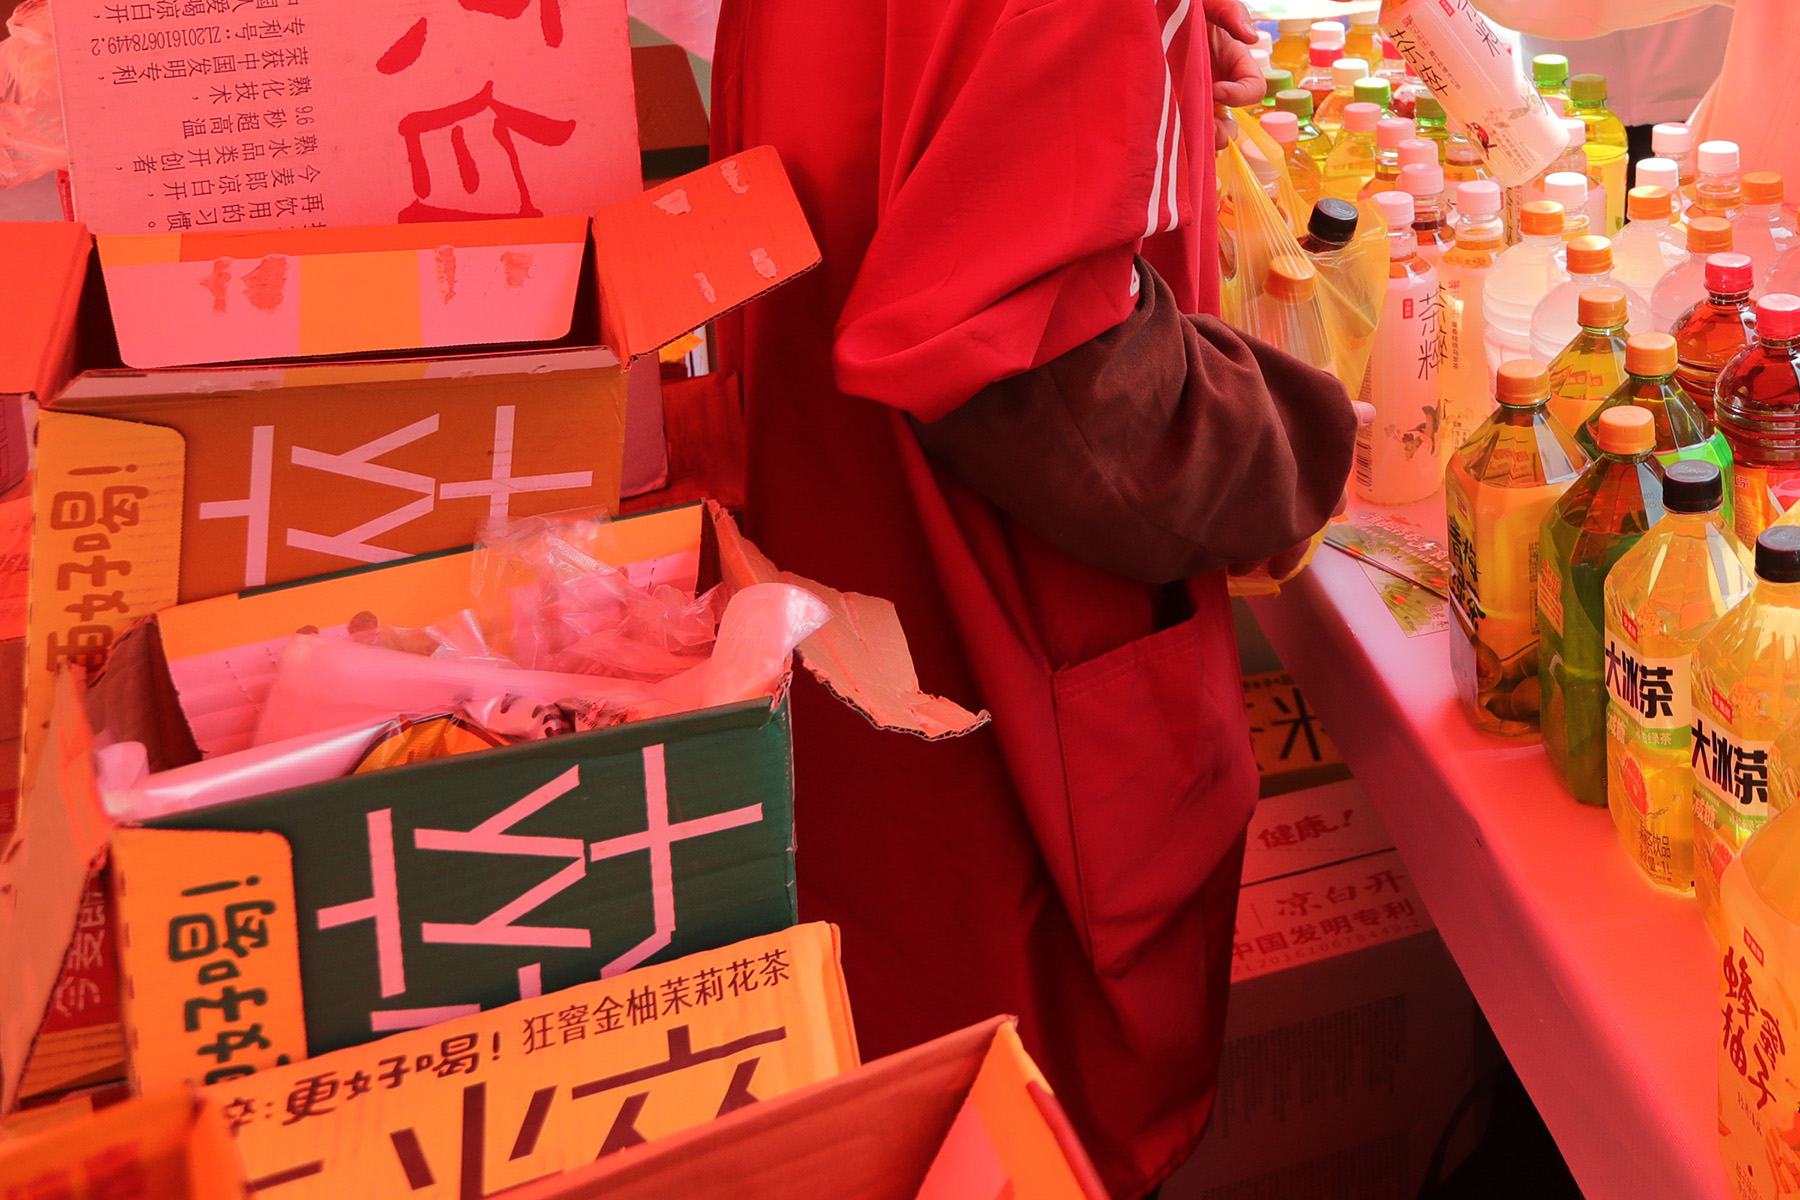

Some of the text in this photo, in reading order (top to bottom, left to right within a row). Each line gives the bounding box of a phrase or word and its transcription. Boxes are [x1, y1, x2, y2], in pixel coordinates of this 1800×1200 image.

[1605, 640, 1673, 719] 大冰茶
[1691, 719, 1768, 806] 大冰茶
